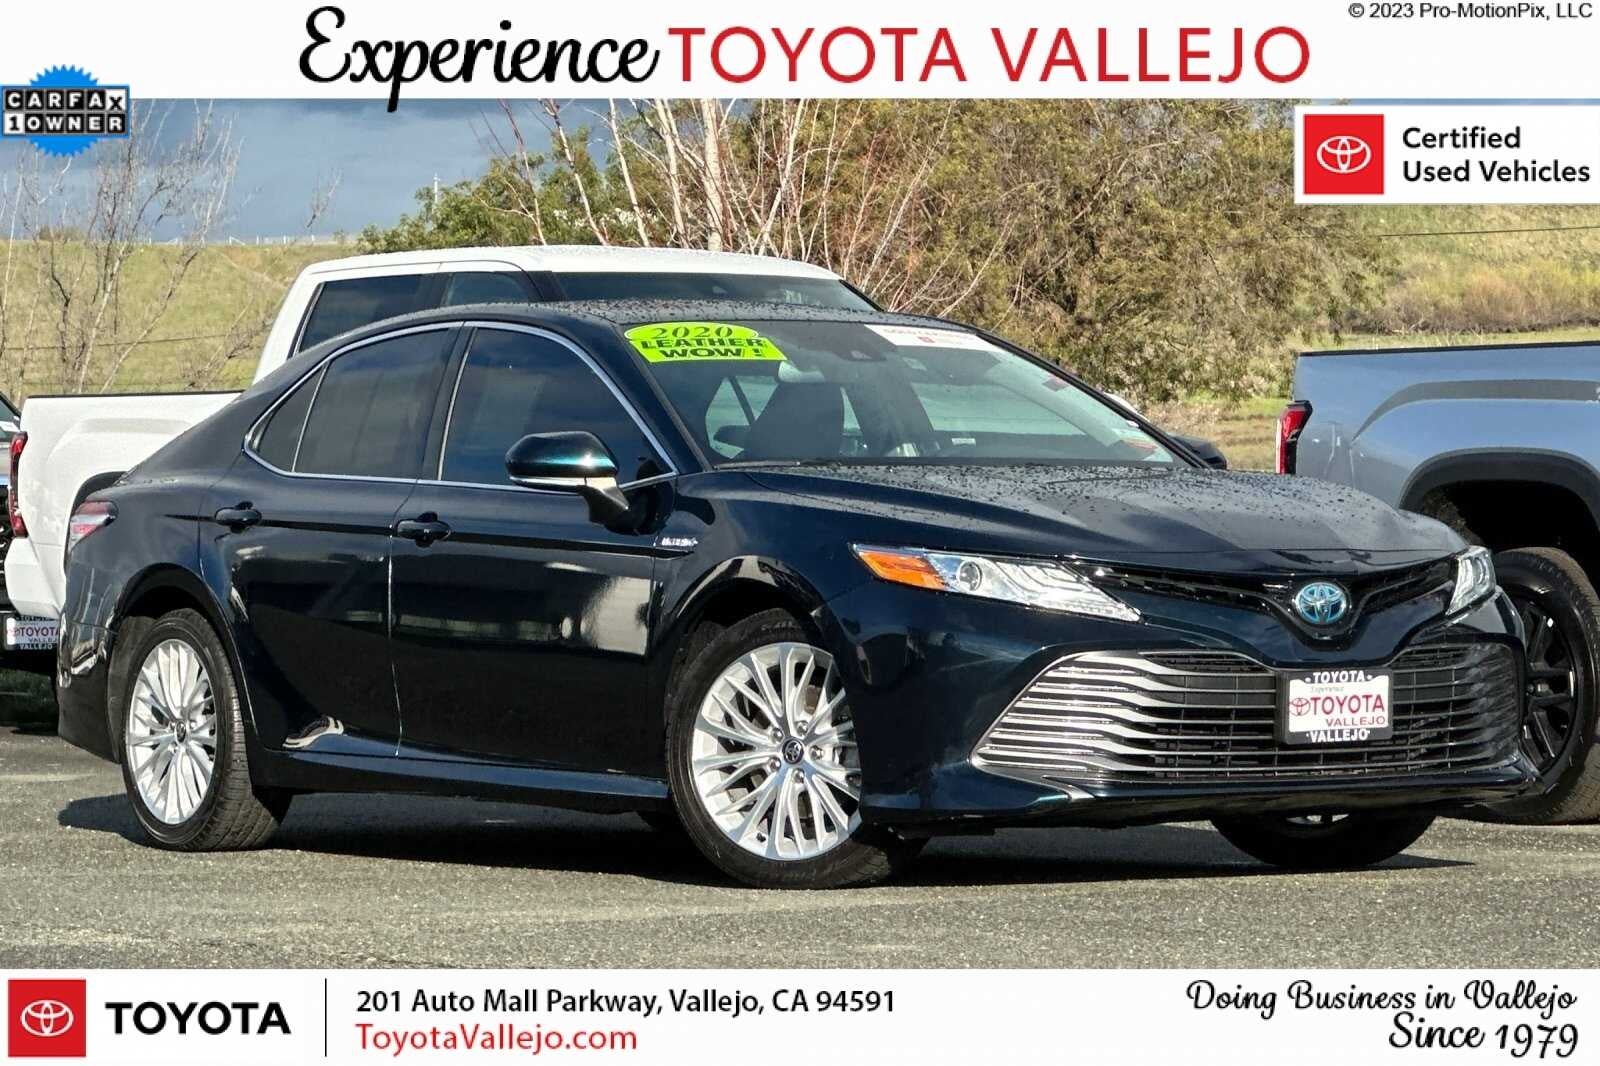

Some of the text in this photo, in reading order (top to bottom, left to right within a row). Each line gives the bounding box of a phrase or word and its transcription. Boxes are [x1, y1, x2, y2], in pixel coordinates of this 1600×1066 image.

[651, 326, 733, 339] 2020
[640, 338, 764, 349] LEATHER
[1312, 670, 1365, 683] TOYOTA
[1310, 694, 1385, 716] TOYOTA
[1326, 716, 1386, 727] VALLEJO
[1310, 728, 1368, 743] VALLEJO
